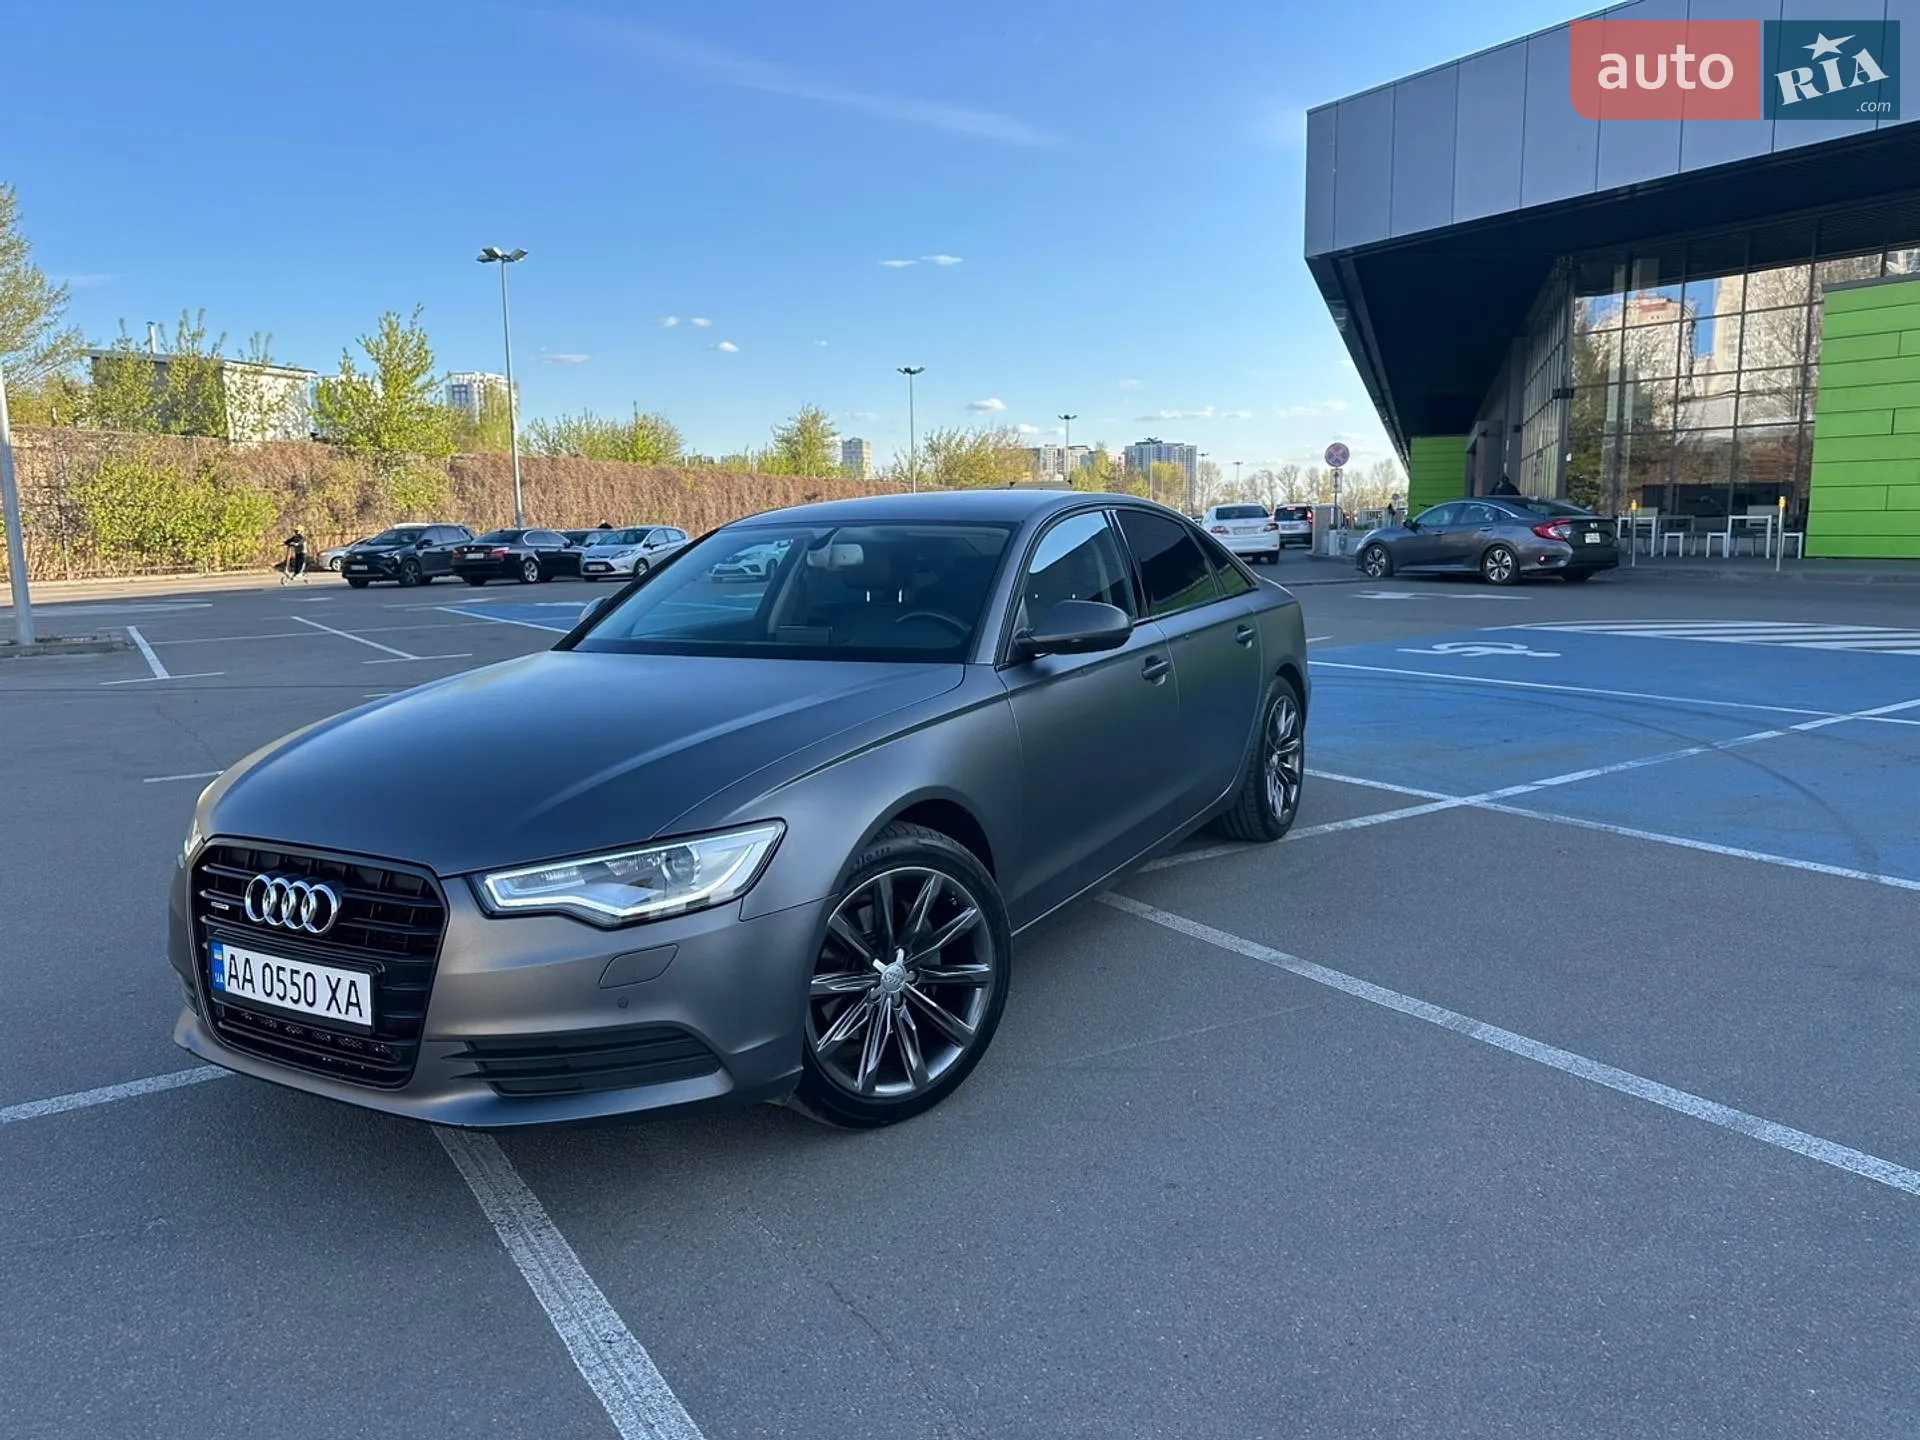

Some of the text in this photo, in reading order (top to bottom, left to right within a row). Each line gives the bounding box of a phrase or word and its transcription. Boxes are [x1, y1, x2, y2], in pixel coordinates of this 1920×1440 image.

[227, 953, 363, 1018] AA 0550 XA
